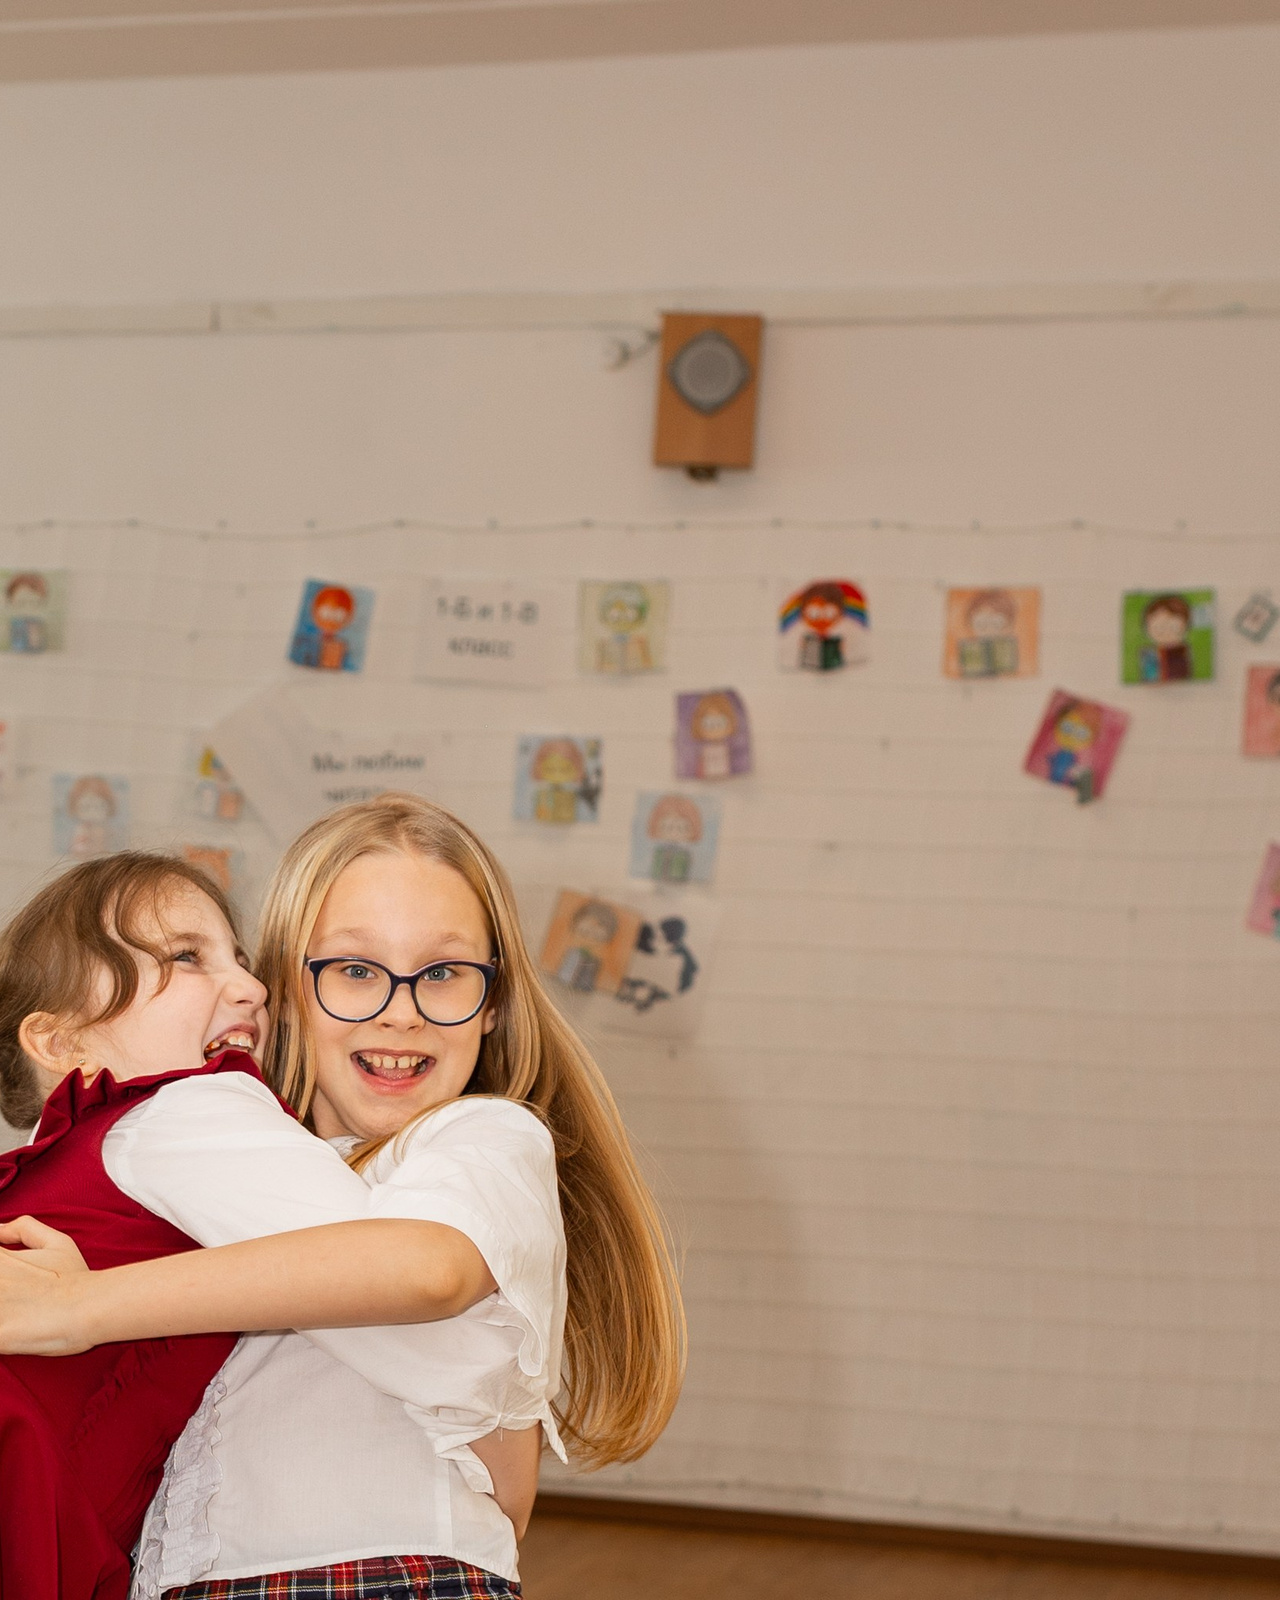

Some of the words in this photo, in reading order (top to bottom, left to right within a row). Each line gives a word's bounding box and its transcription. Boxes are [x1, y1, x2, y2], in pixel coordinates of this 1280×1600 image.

[447, 636, 515, 659] класс
[311, 752, 346, 773] Мы
[351, 751, 426, 774] любим
